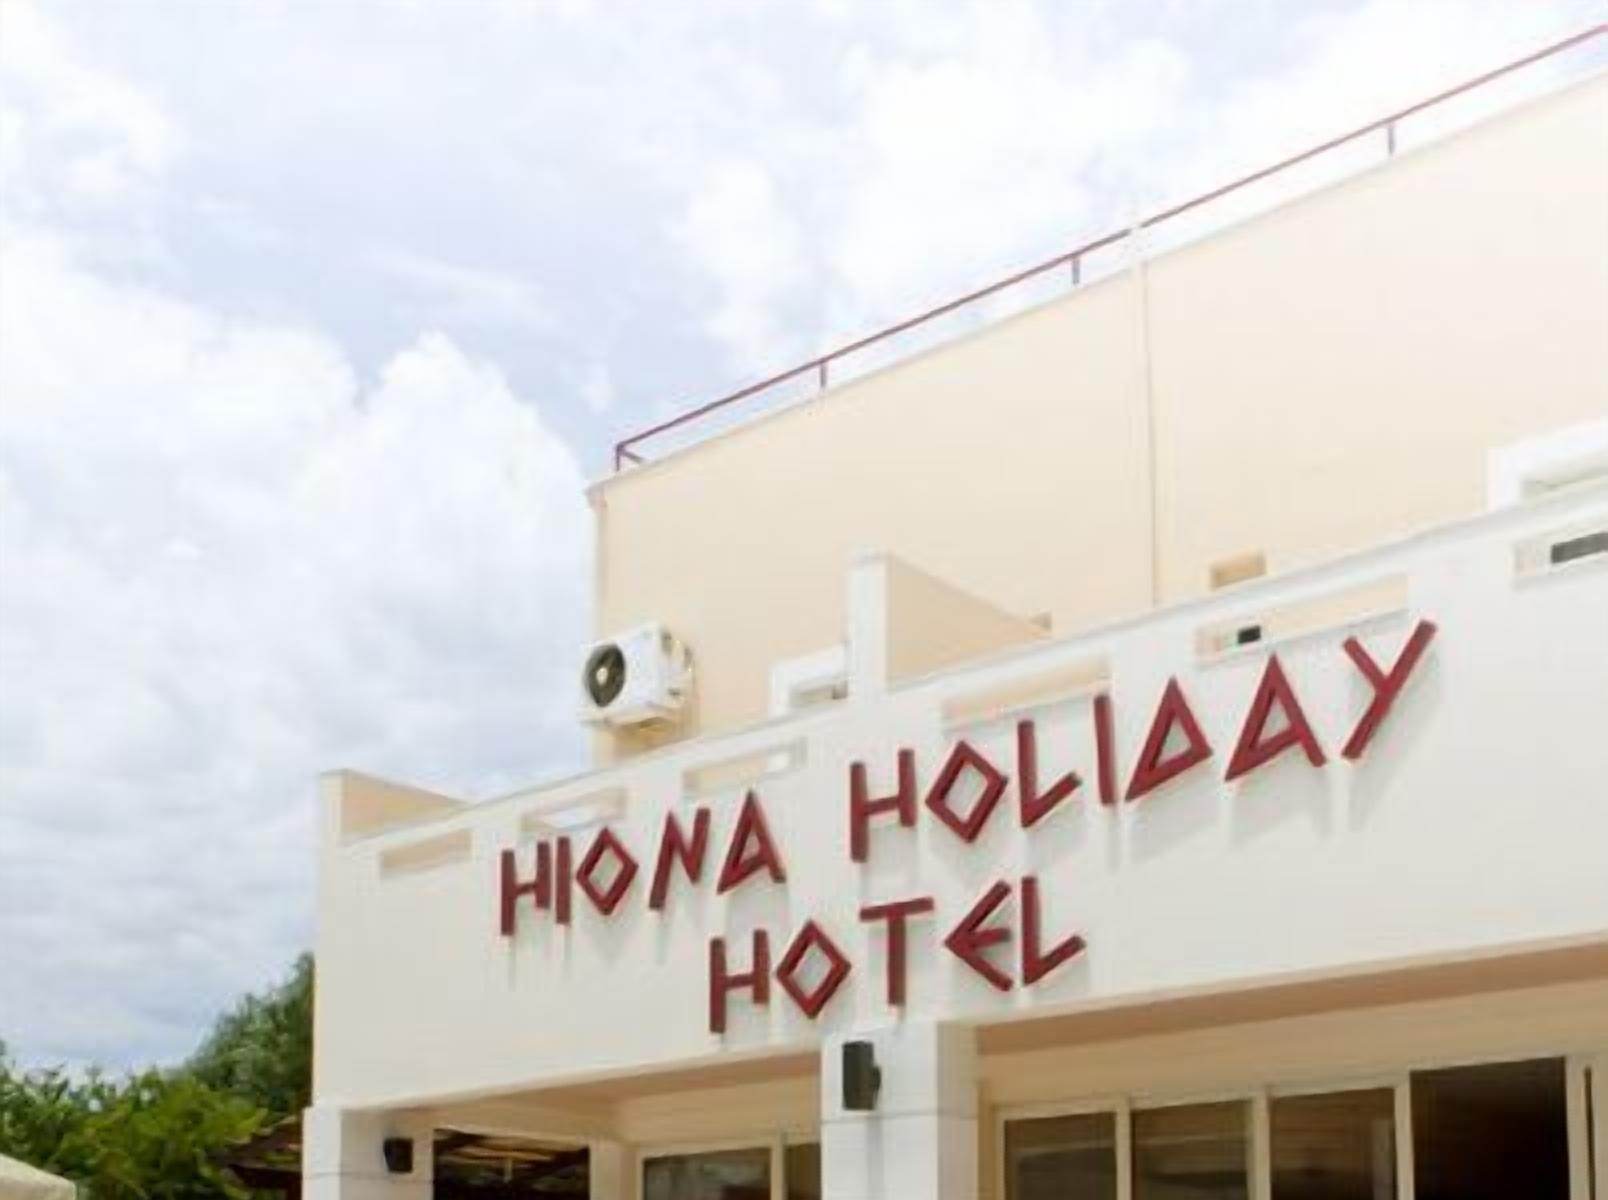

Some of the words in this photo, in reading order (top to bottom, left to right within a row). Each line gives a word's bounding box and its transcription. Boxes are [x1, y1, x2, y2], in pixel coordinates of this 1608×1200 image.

[500, 790, 787, 936] HIONA
[849, 620, 1438, 863] HOLIDAY
[709, 876, 1087, 1034] HOTEL
